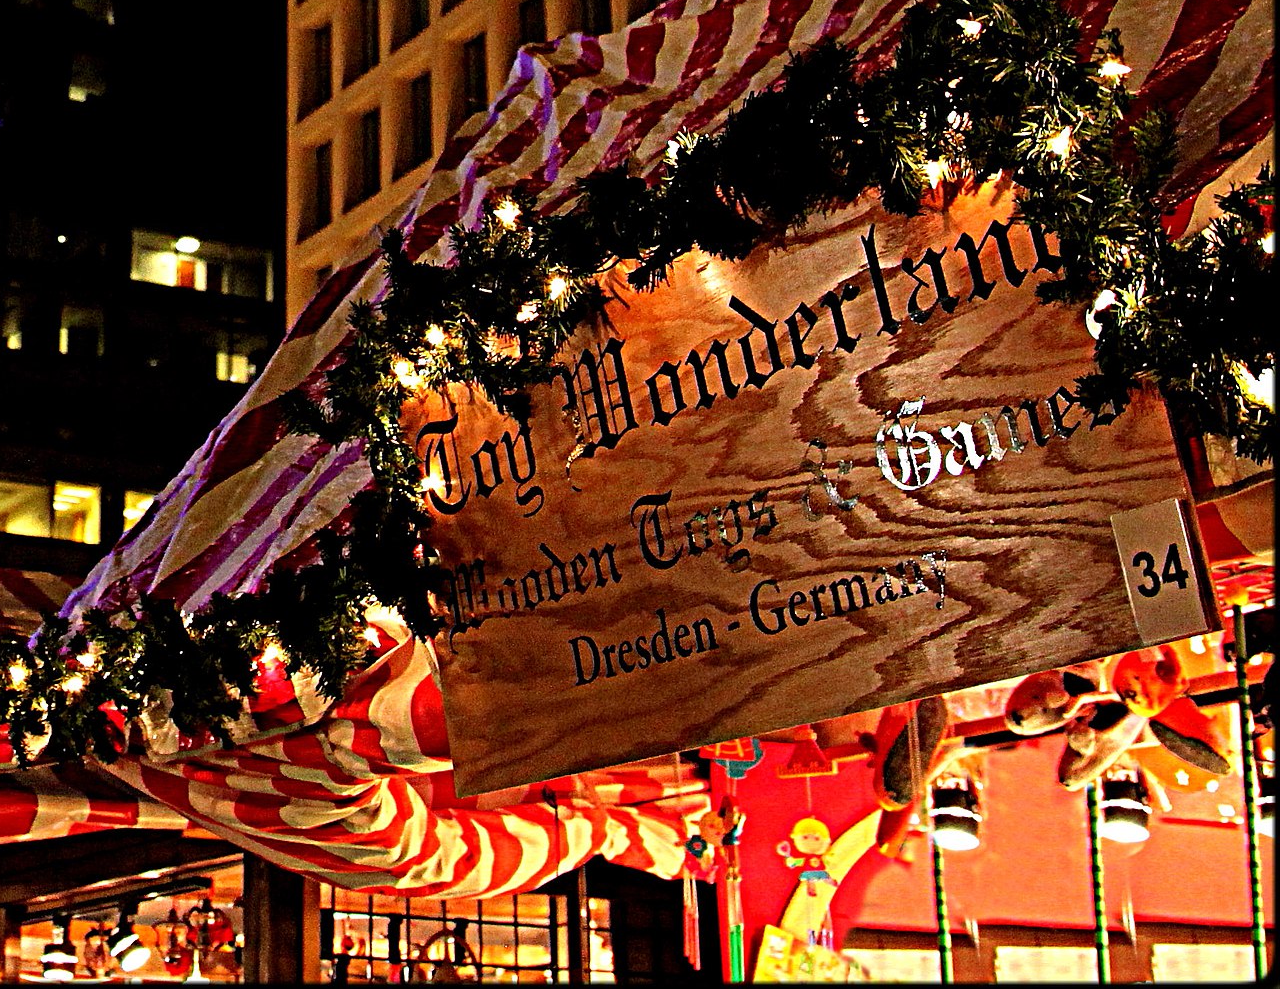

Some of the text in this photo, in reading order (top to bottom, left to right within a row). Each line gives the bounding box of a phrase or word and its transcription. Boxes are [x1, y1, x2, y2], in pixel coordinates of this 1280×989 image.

[416, 412, 544, 517] Toy
[444, 542, 622, 654] Wooden
[631, 488, 777, 571] Toys
[568, 610, 720, 686] Dresden
[749, 550, 948, 636] Germany
[1131, 544, 1189, 598] 34
